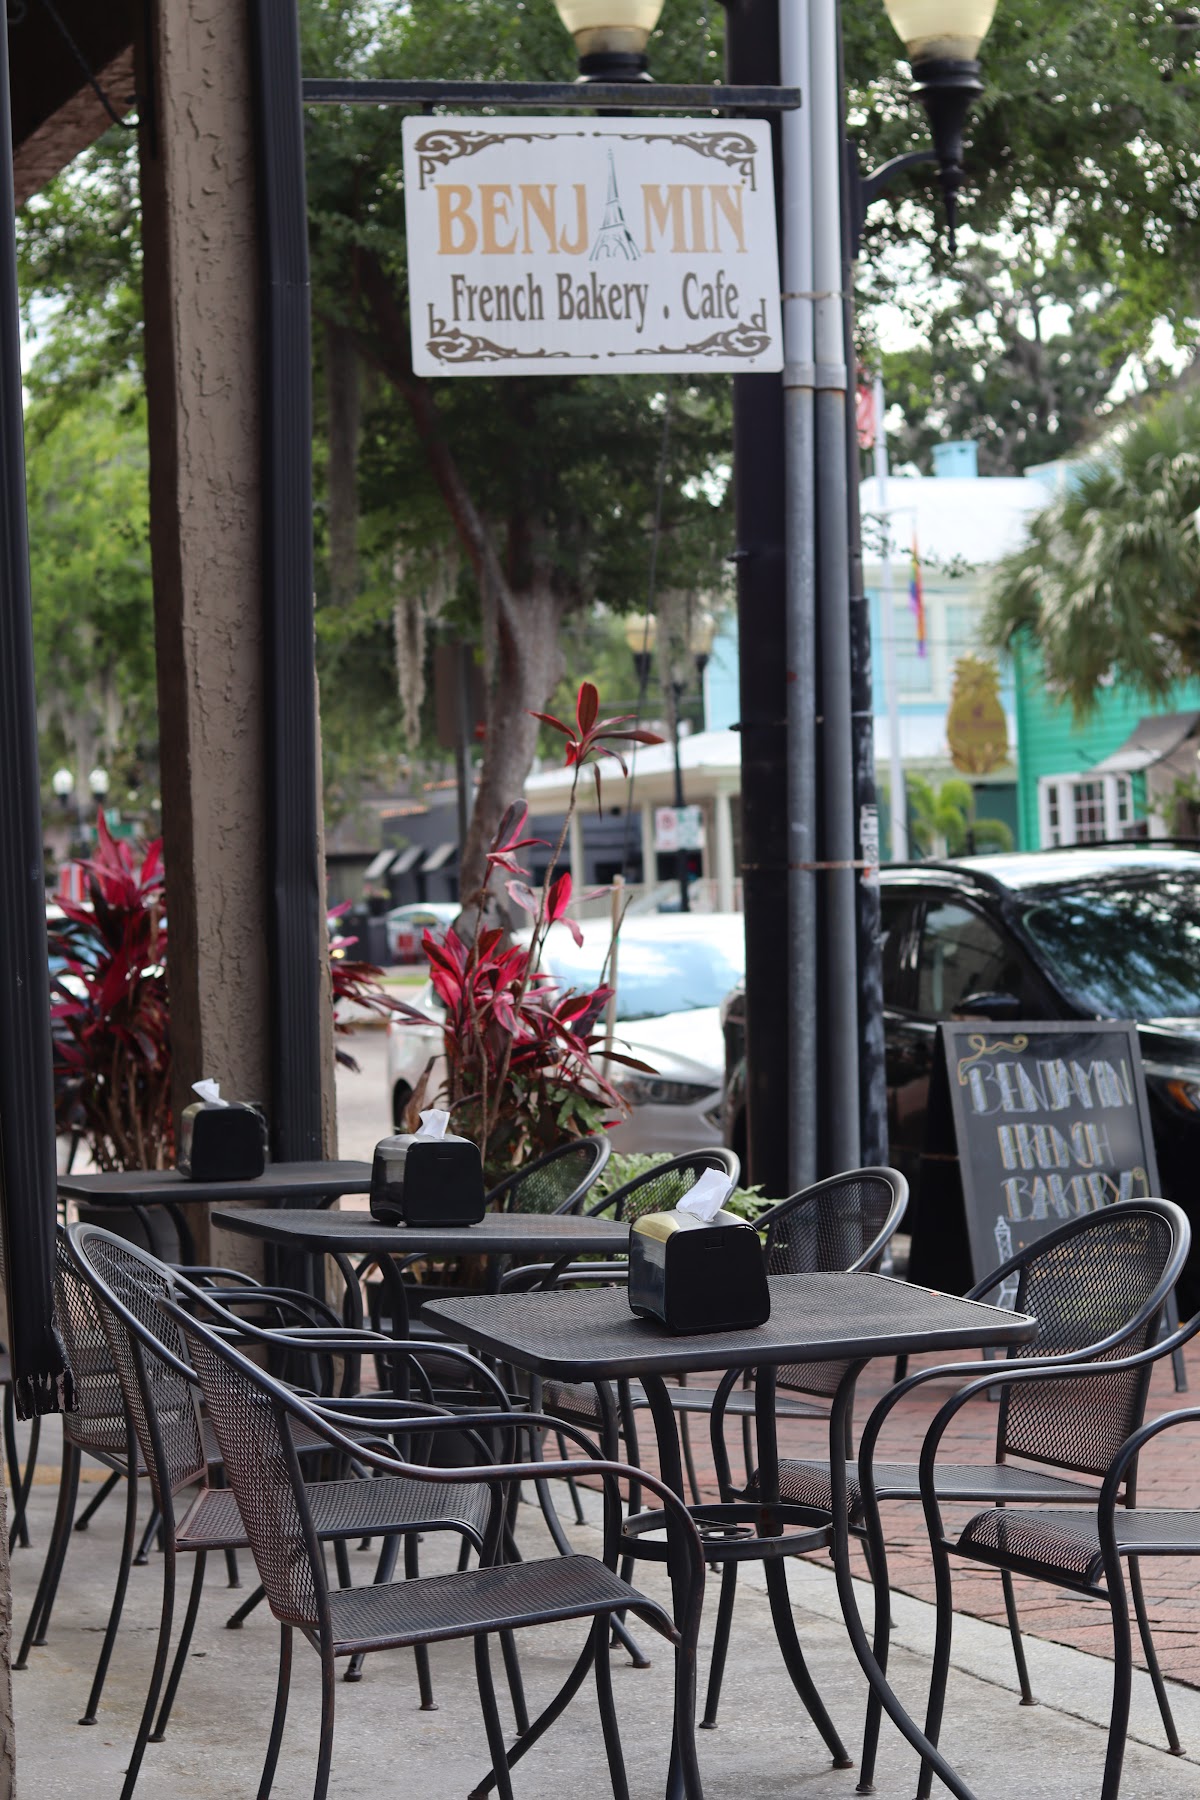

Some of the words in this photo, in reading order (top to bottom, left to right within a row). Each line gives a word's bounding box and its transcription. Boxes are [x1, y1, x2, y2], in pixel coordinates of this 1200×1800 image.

[451, 272, 545, 322] French
[556, 271, 649, 333] Bakery
[682, 269, 739, 321] Cafe
[961, 1058, 1133, 1116] BENJAMIN
[997, 1121, 1116, 1170] FRENCH
